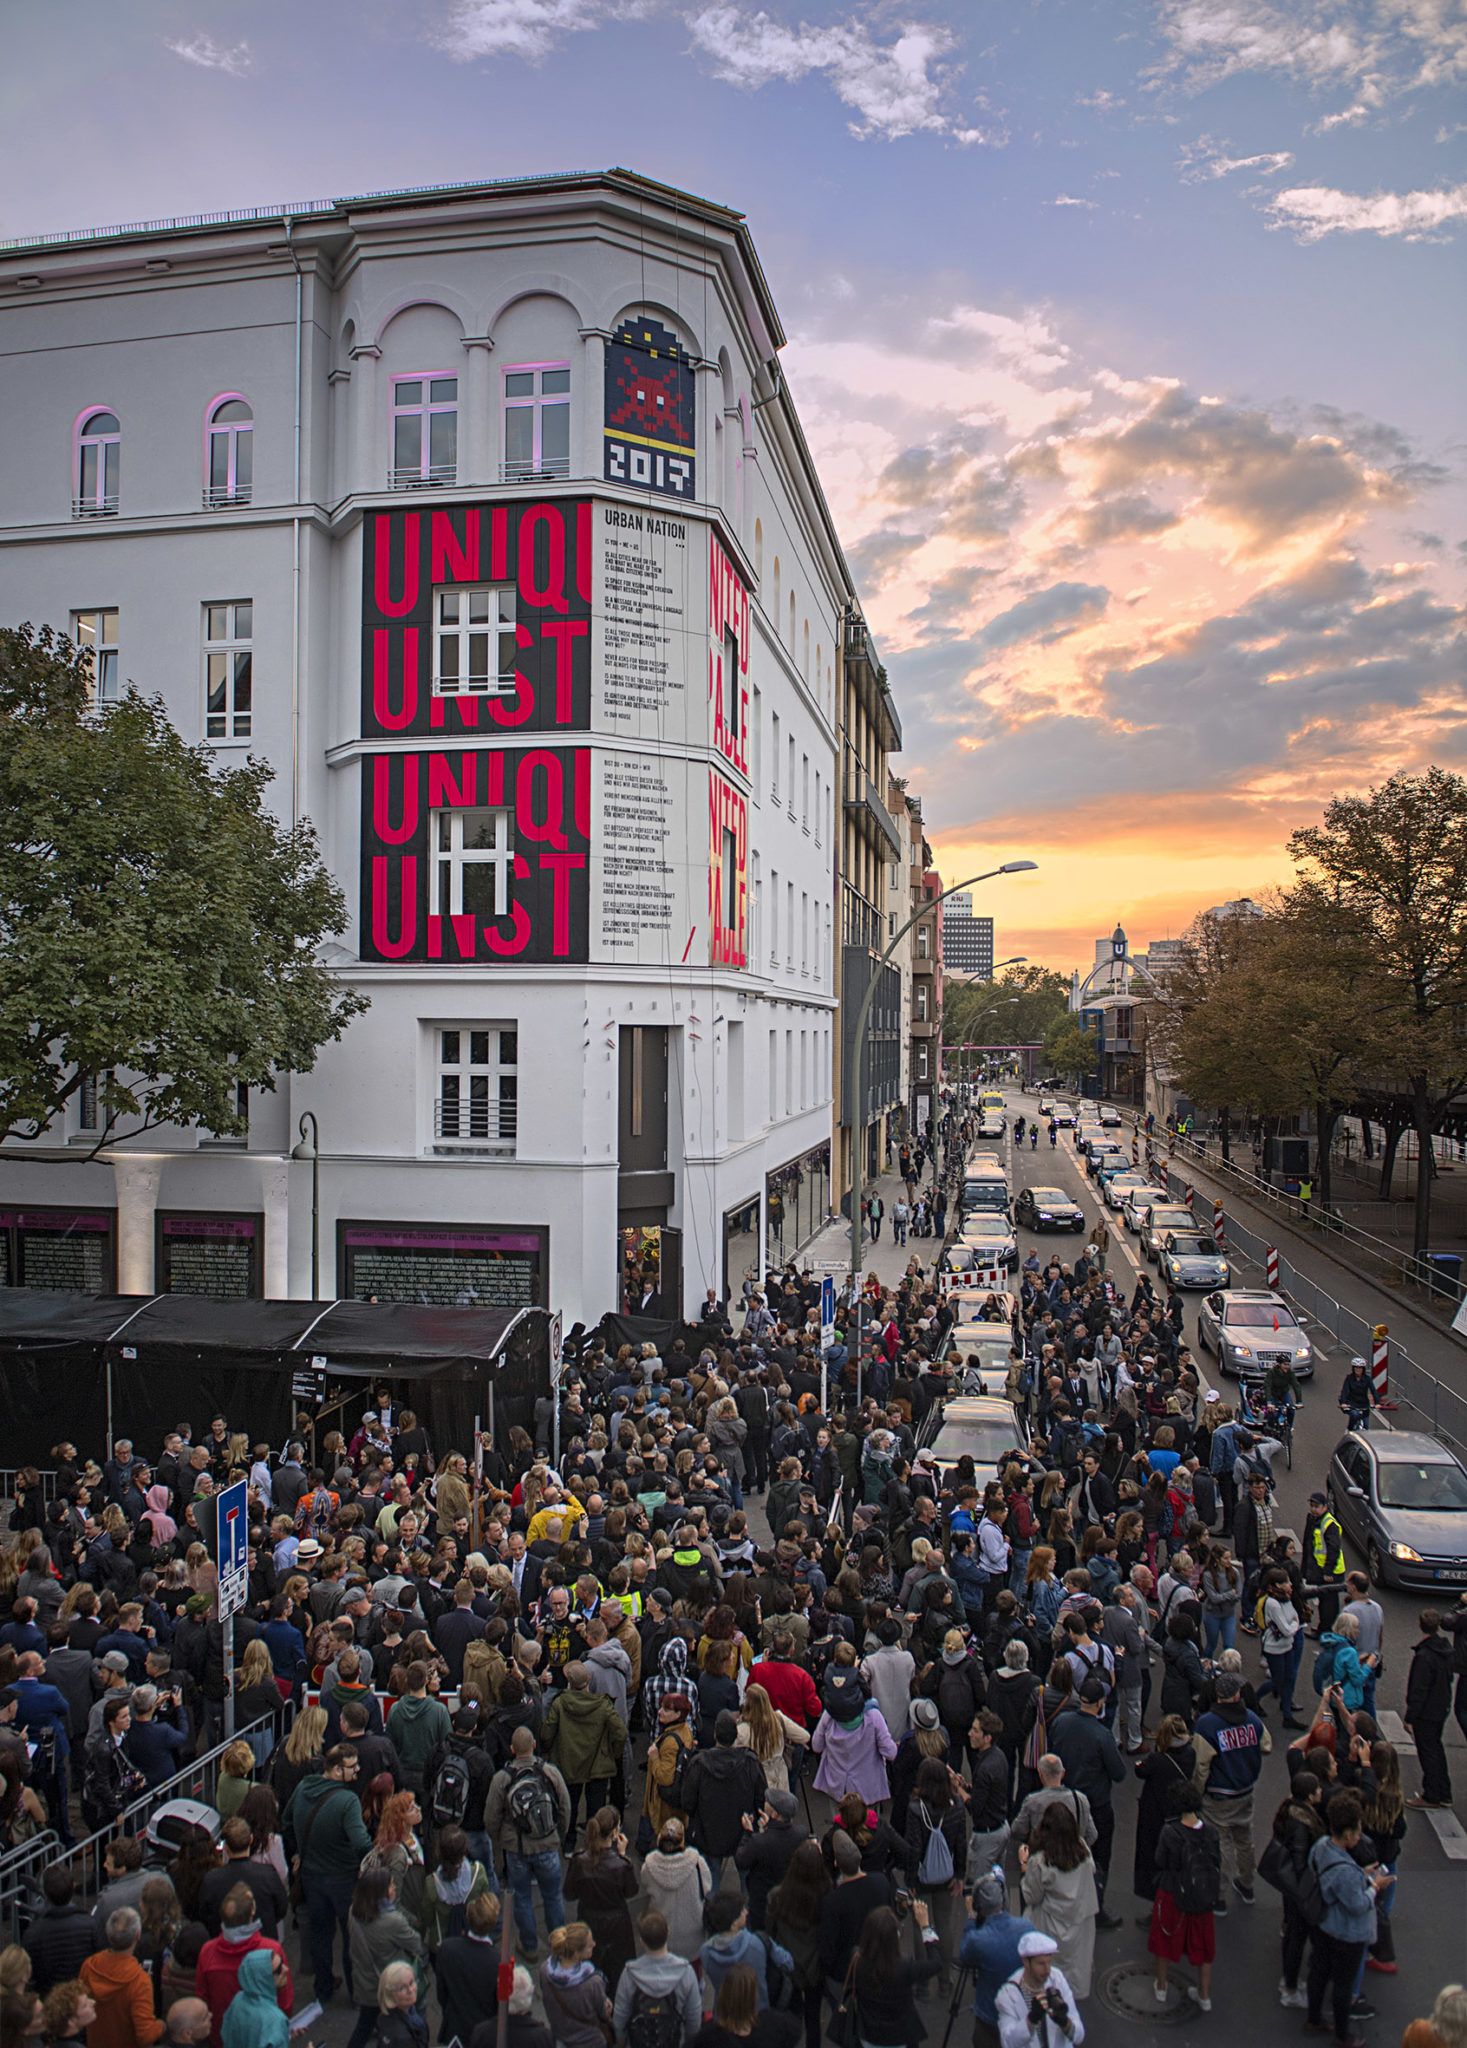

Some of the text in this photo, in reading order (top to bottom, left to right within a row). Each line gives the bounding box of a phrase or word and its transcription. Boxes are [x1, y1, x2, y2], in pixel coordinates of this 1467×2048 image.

[610, 444, 690, 491] 2017
[605, 509, 685, 540] URBAN NATION
[1115, 944, 1124, 954] U
[1226, 1724, 1258, 1750] NBA
